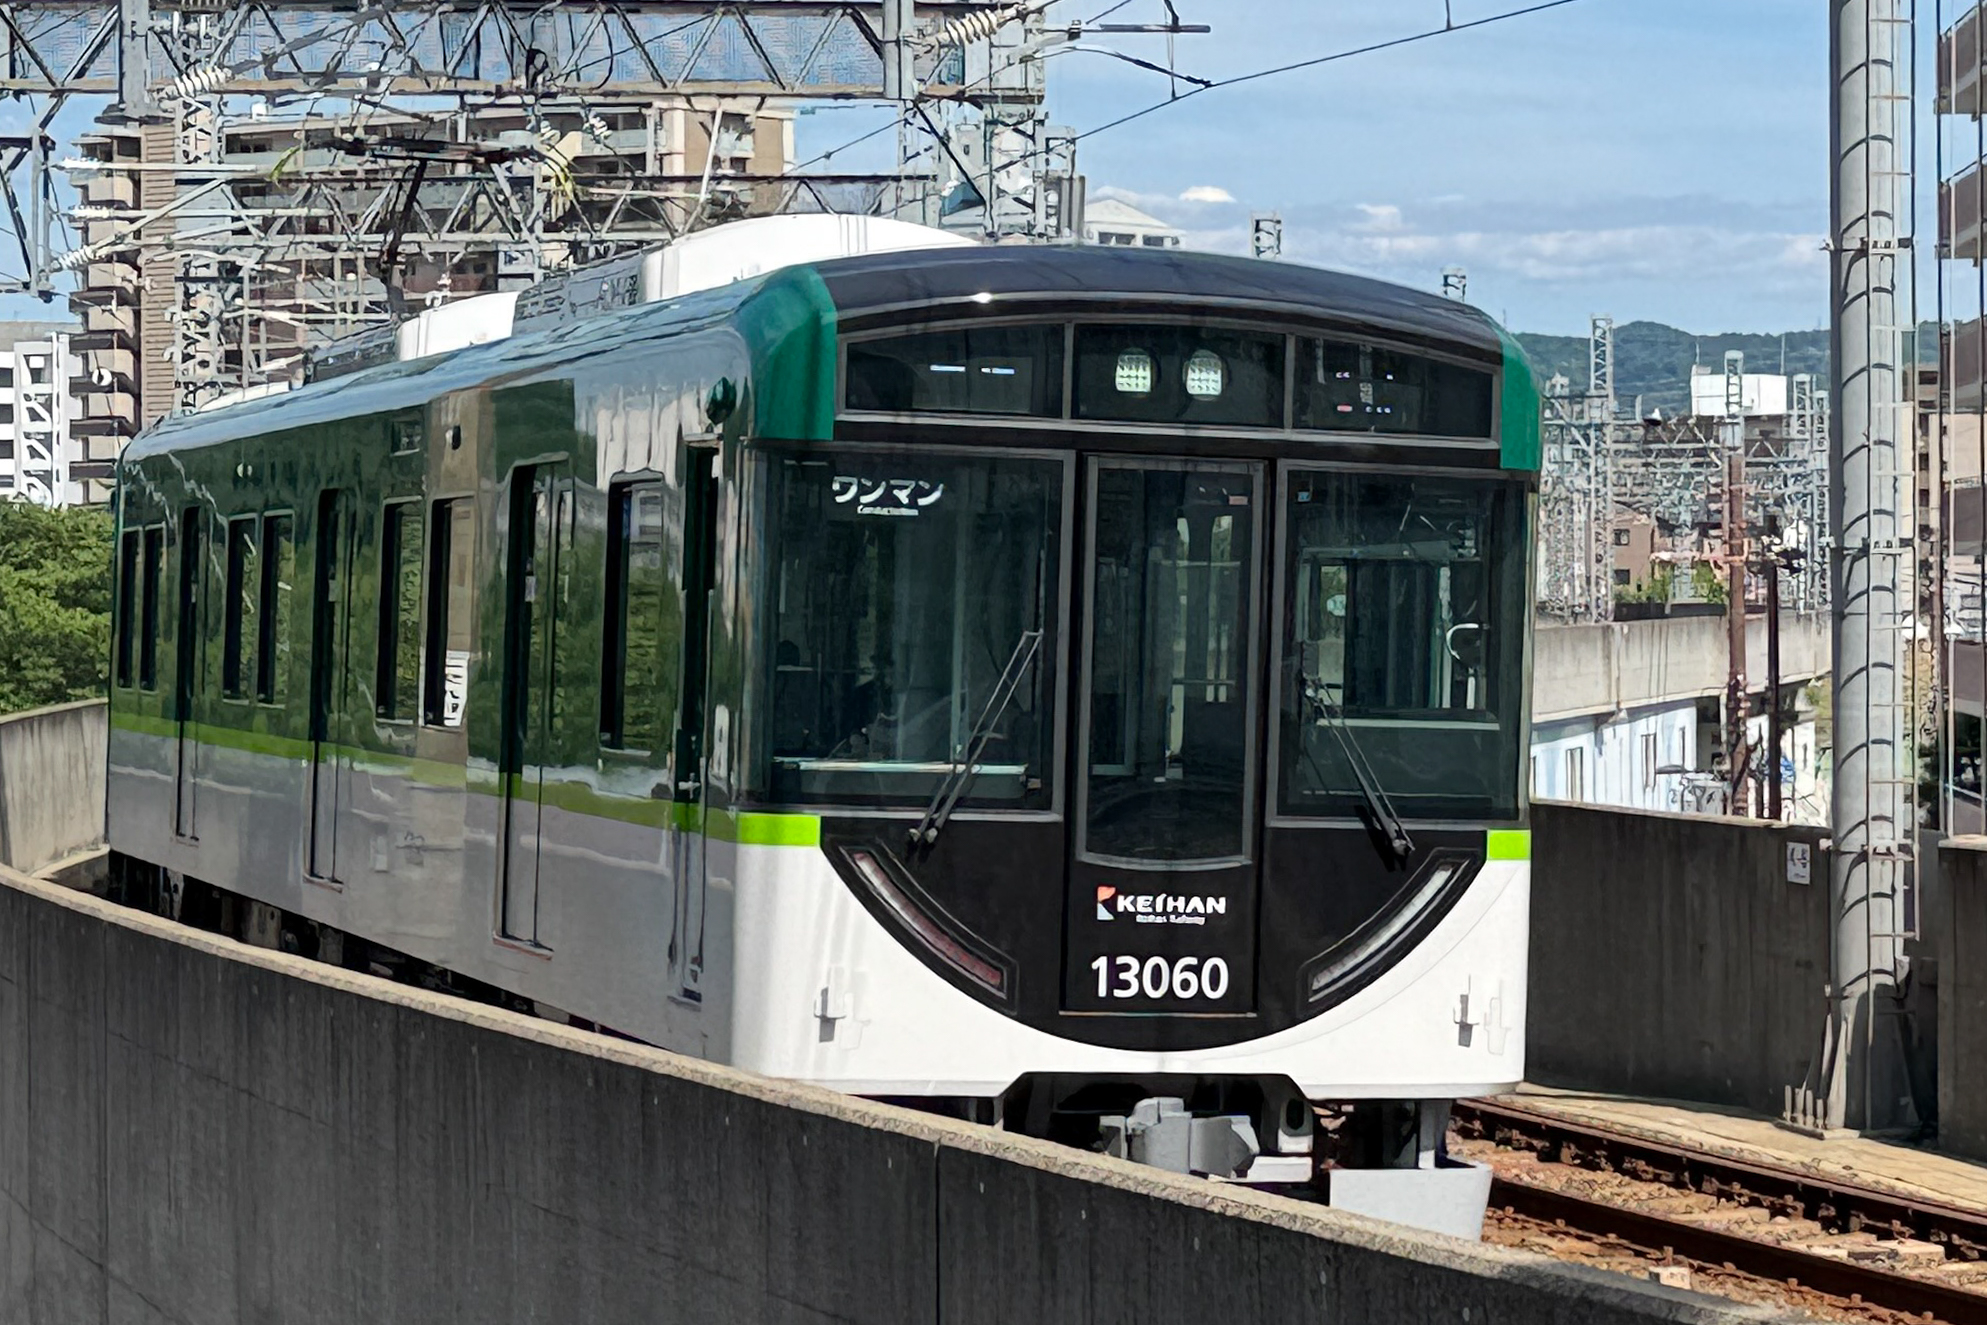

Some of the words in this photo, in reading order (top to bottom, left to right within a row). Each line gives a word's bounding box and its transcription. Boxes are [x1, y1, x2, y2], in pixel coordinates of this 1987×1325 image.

[832, 475, 944, 506] ワンマン
[1116, 893, 1226, 914] KEIHAN
[1091, 955, 1229, 1000] 13060
